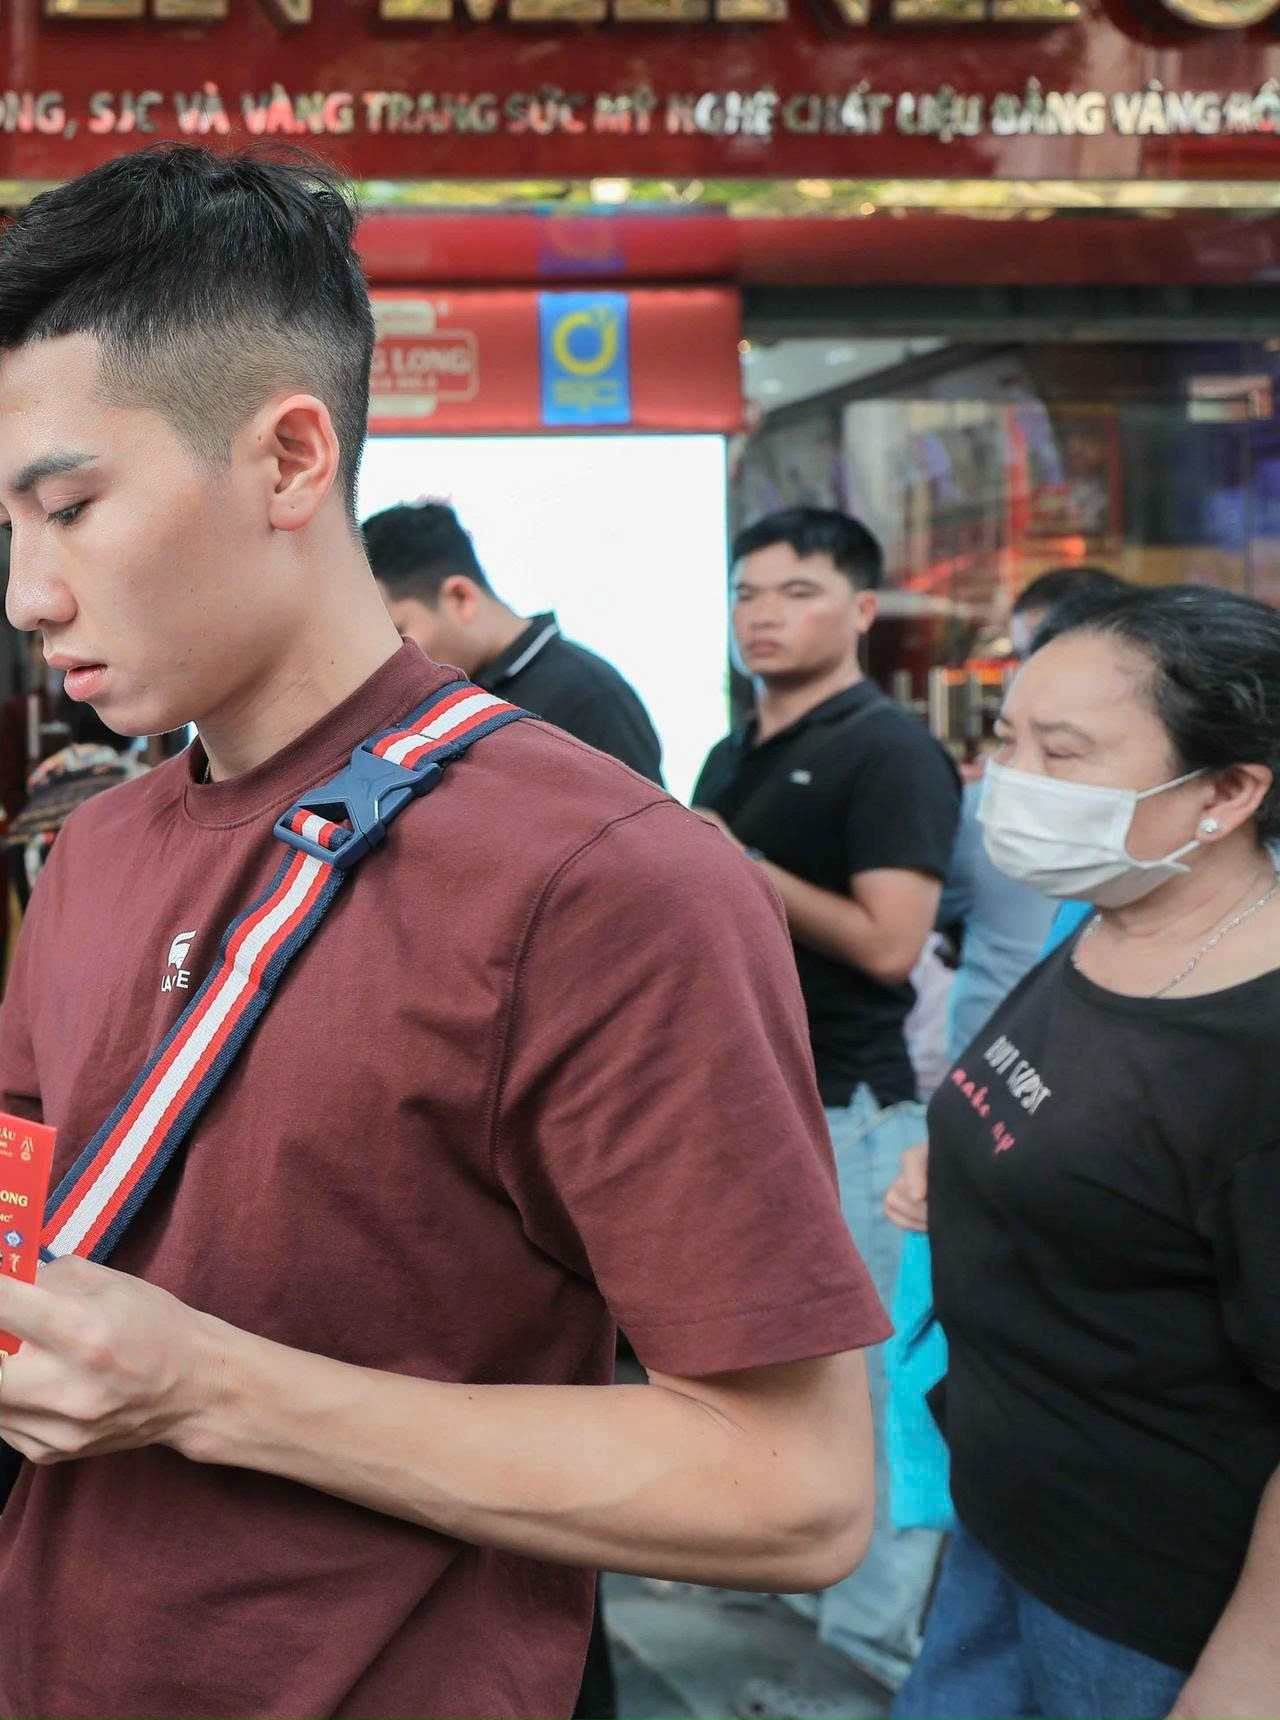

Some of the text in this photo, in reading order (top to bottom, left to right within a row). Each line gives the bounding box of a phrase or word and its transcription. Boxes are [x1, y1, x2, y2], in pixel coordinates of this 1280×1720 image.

[88, 90, 161, 134] SJC
[174, 82, 231, 135] VÀ
[242, 82, 355, 134] VÀNG
[362, 90, 498, 135] TRANG
[1111, 78, 1219, 135] VÀNG
[391, 346, 473, 376] LONG
